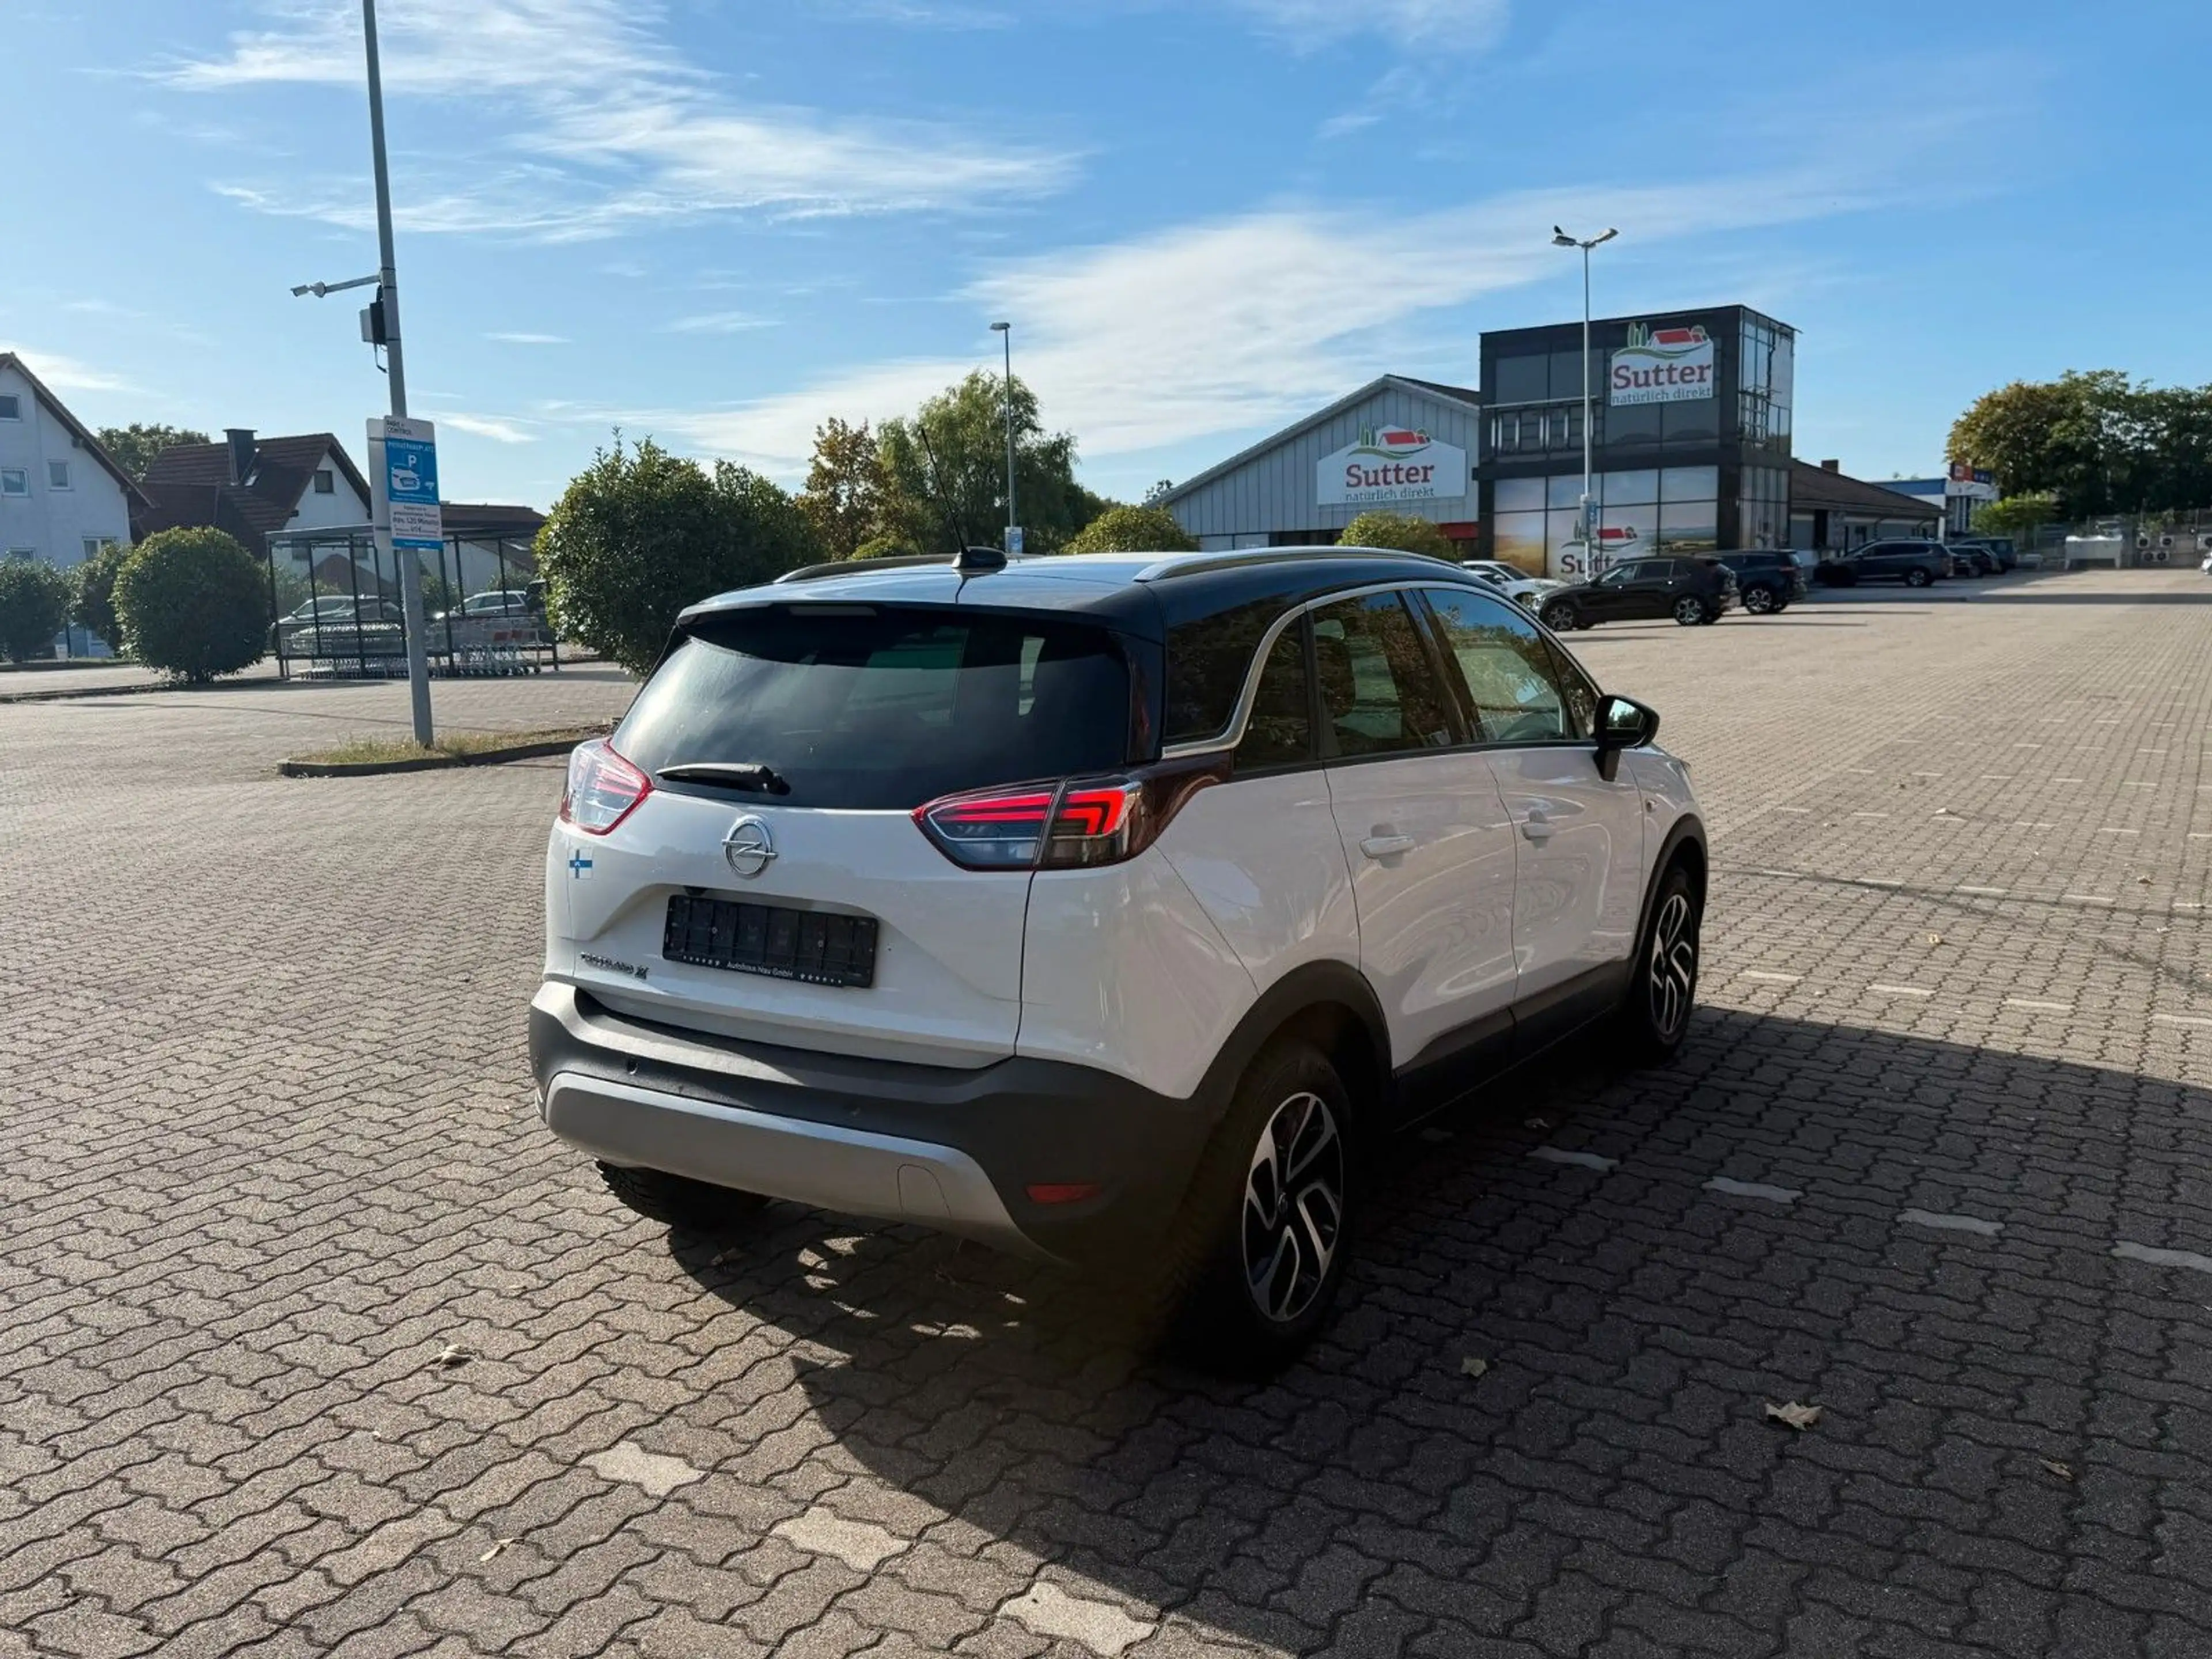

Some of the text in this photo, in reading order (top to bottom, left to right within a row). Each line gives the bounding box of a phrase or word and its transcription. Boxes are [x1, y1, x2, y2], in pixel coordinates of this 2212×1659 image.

[1613, 363, 1712, 390] Sutter
[1613, 387, 1711, 404] natürlich direkt
[408, 454, 417, 467] P
[1346, 463, 1435, 488] Sutter
[1346, 488, 1434, 502] natürlich direkt
